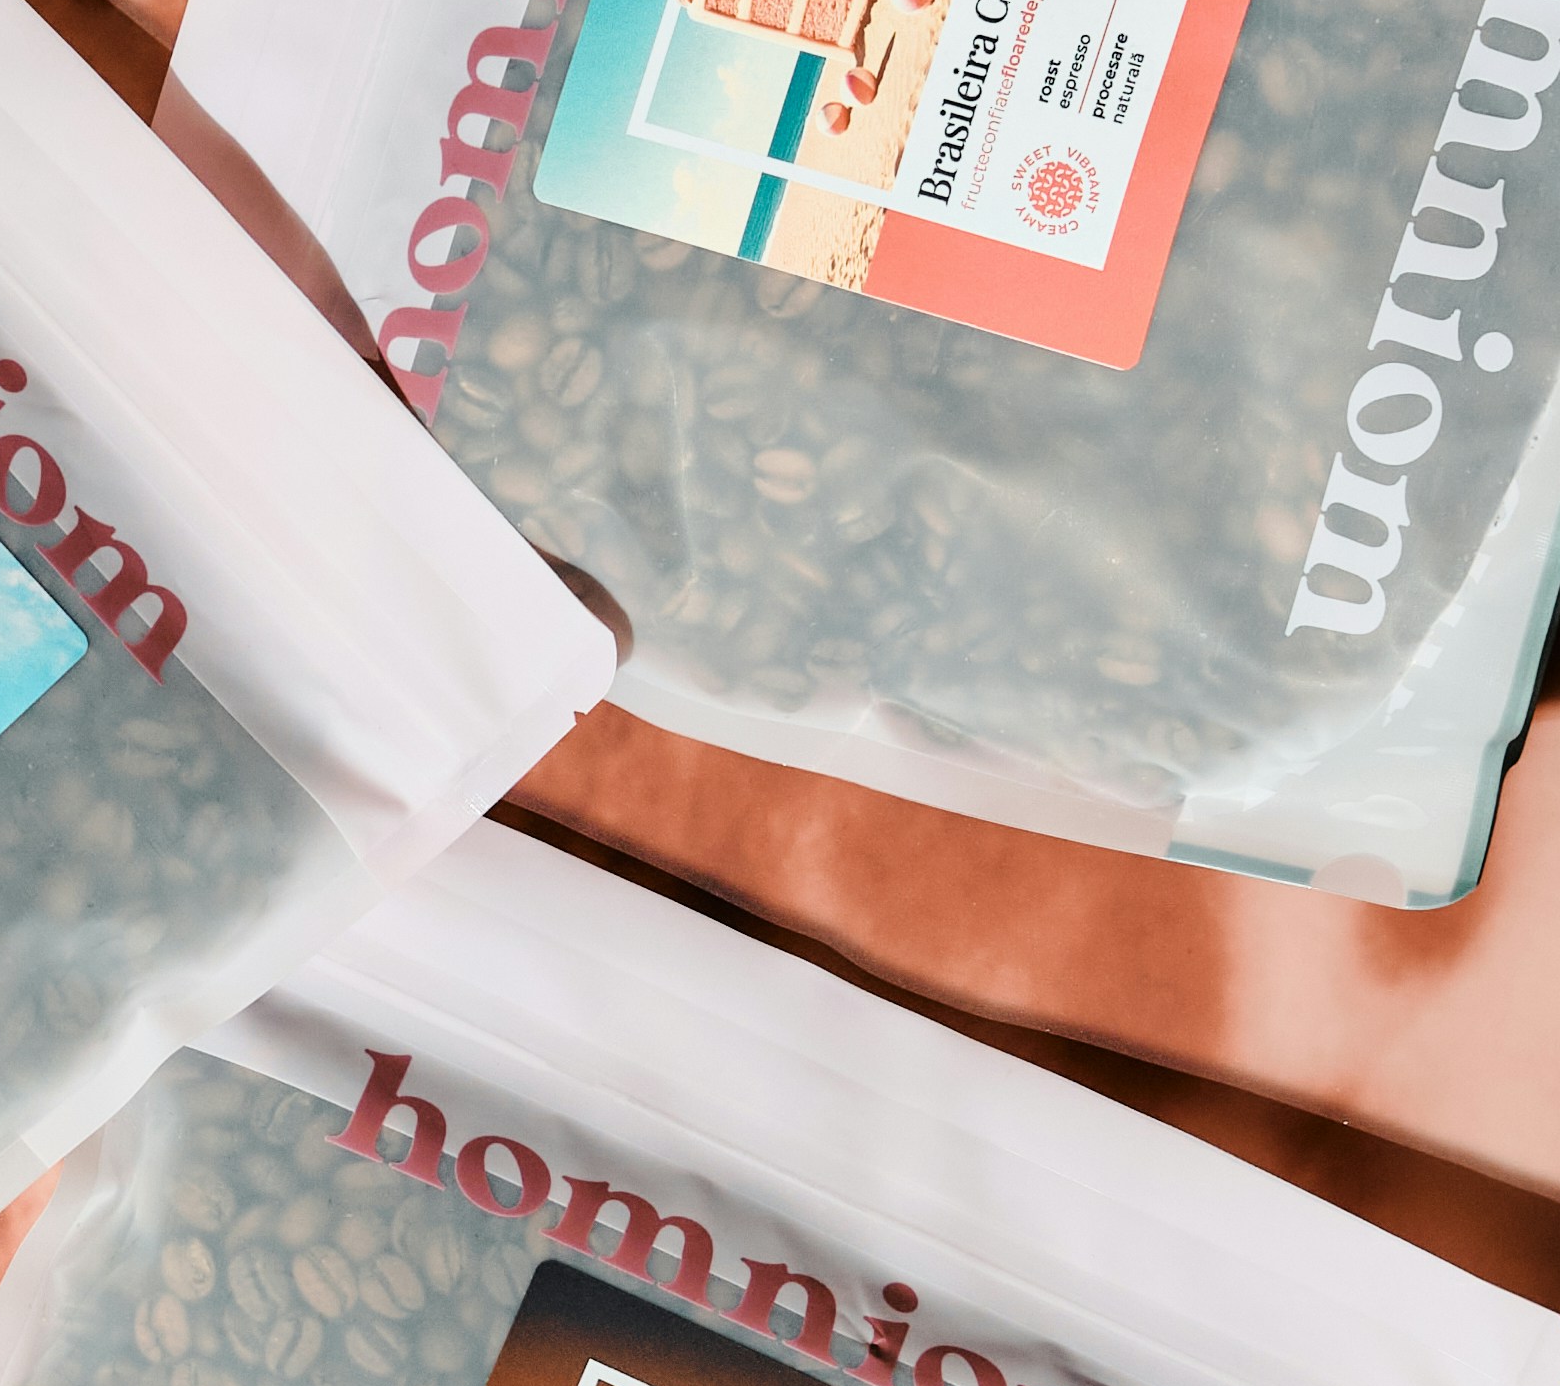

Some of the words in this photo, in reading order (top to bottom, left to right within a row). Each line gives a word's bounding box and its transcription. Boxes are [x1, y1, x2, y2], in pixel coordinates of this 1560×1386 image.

[1039, 59, 1061, 103] roast
[1060, 35, 1091, 109] espresso
[1092, 33, 1128, 119] procesare
[1113, 53, 1144, 124] naturală
[917, 34, 999, 206] Brasileira
[1012, 145, 1051, 191] SWEET
[1068, 147, 1100, 213] VIBRANT
[1016, 207, 1078, 235] CREAMY
